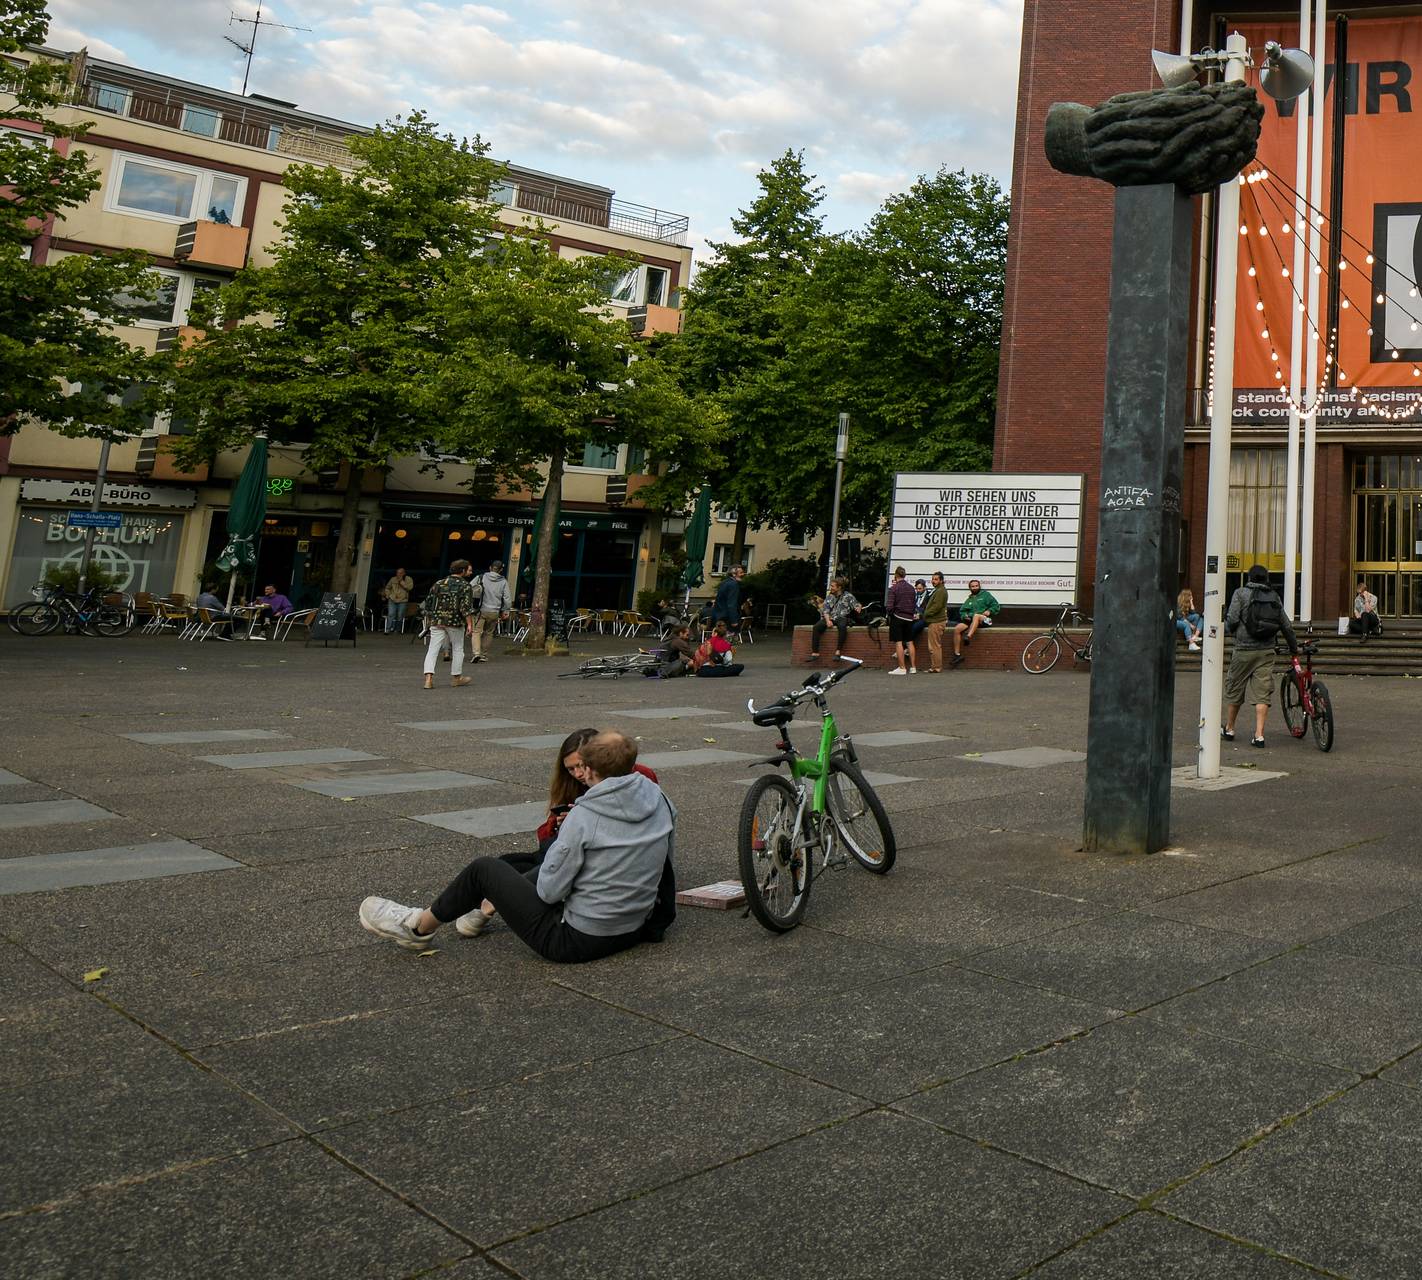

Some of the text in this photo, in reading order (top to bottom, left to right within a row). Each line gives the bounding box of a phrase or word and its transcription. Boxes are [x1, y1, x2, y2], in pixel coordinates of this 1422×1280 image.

[1237, 393, 1286, 403] stand
[939, 490, 1036, 502] WIR SEHEN UNS
[1104, 486, 1154, 498] ANTIFA
[915, 504, 1059, 517] IM SEPTEMBER WIEDER
[507, 517, 535, 525] BISTR
[915, 519, 941, 530] UND
[1020, 520, 1056, 531] EINEN
[986, 533, 1045, 545] SOMMER!
[933, 548, 1033, 560] BLEIBT GESUND!
